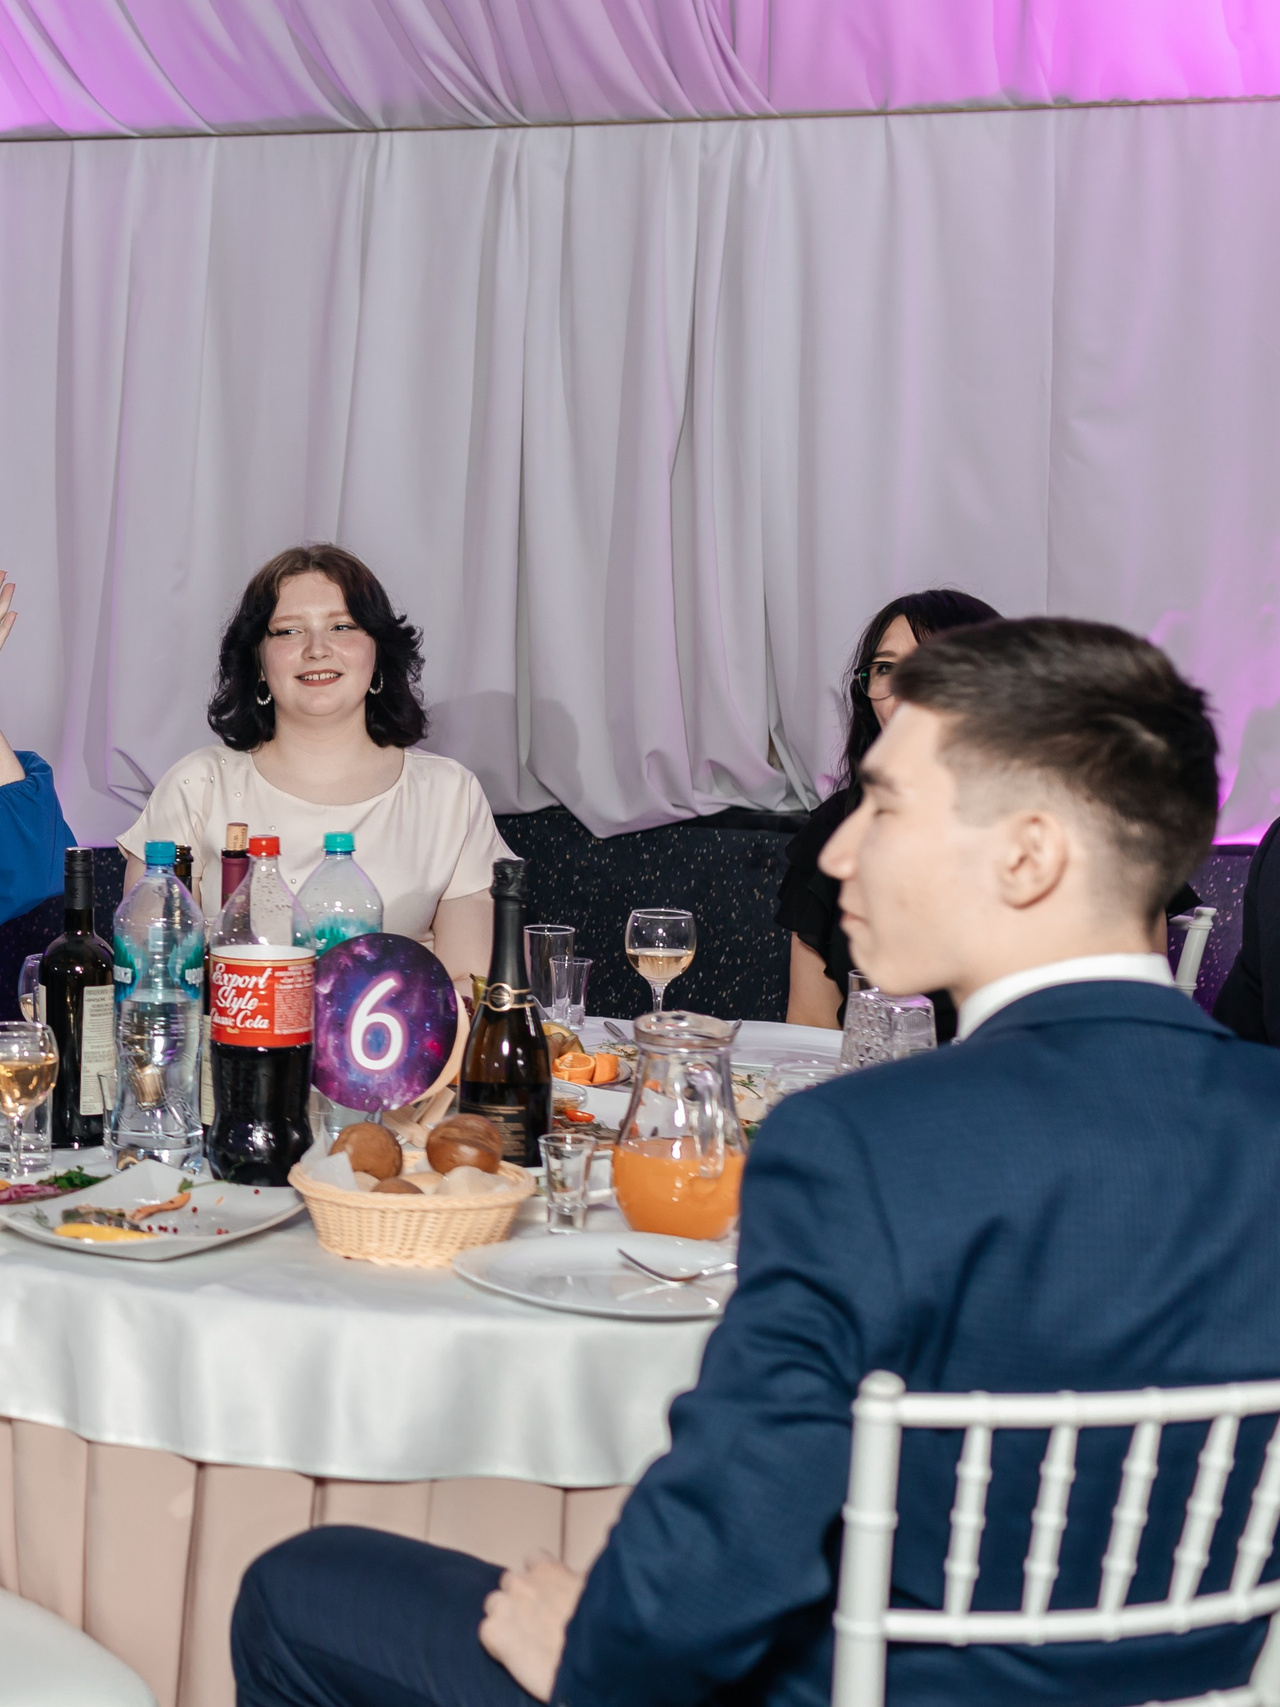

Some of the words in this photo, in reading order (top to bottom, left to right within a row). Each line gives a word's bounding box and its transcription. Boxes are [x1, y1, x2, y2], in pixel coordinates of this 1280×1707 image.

[212, 963, 273, 997] Export
[215, 986, 259, 1016] Style
[236, 1010, 270, 1029] Cola
[351, 978, 403, 1070] 6
